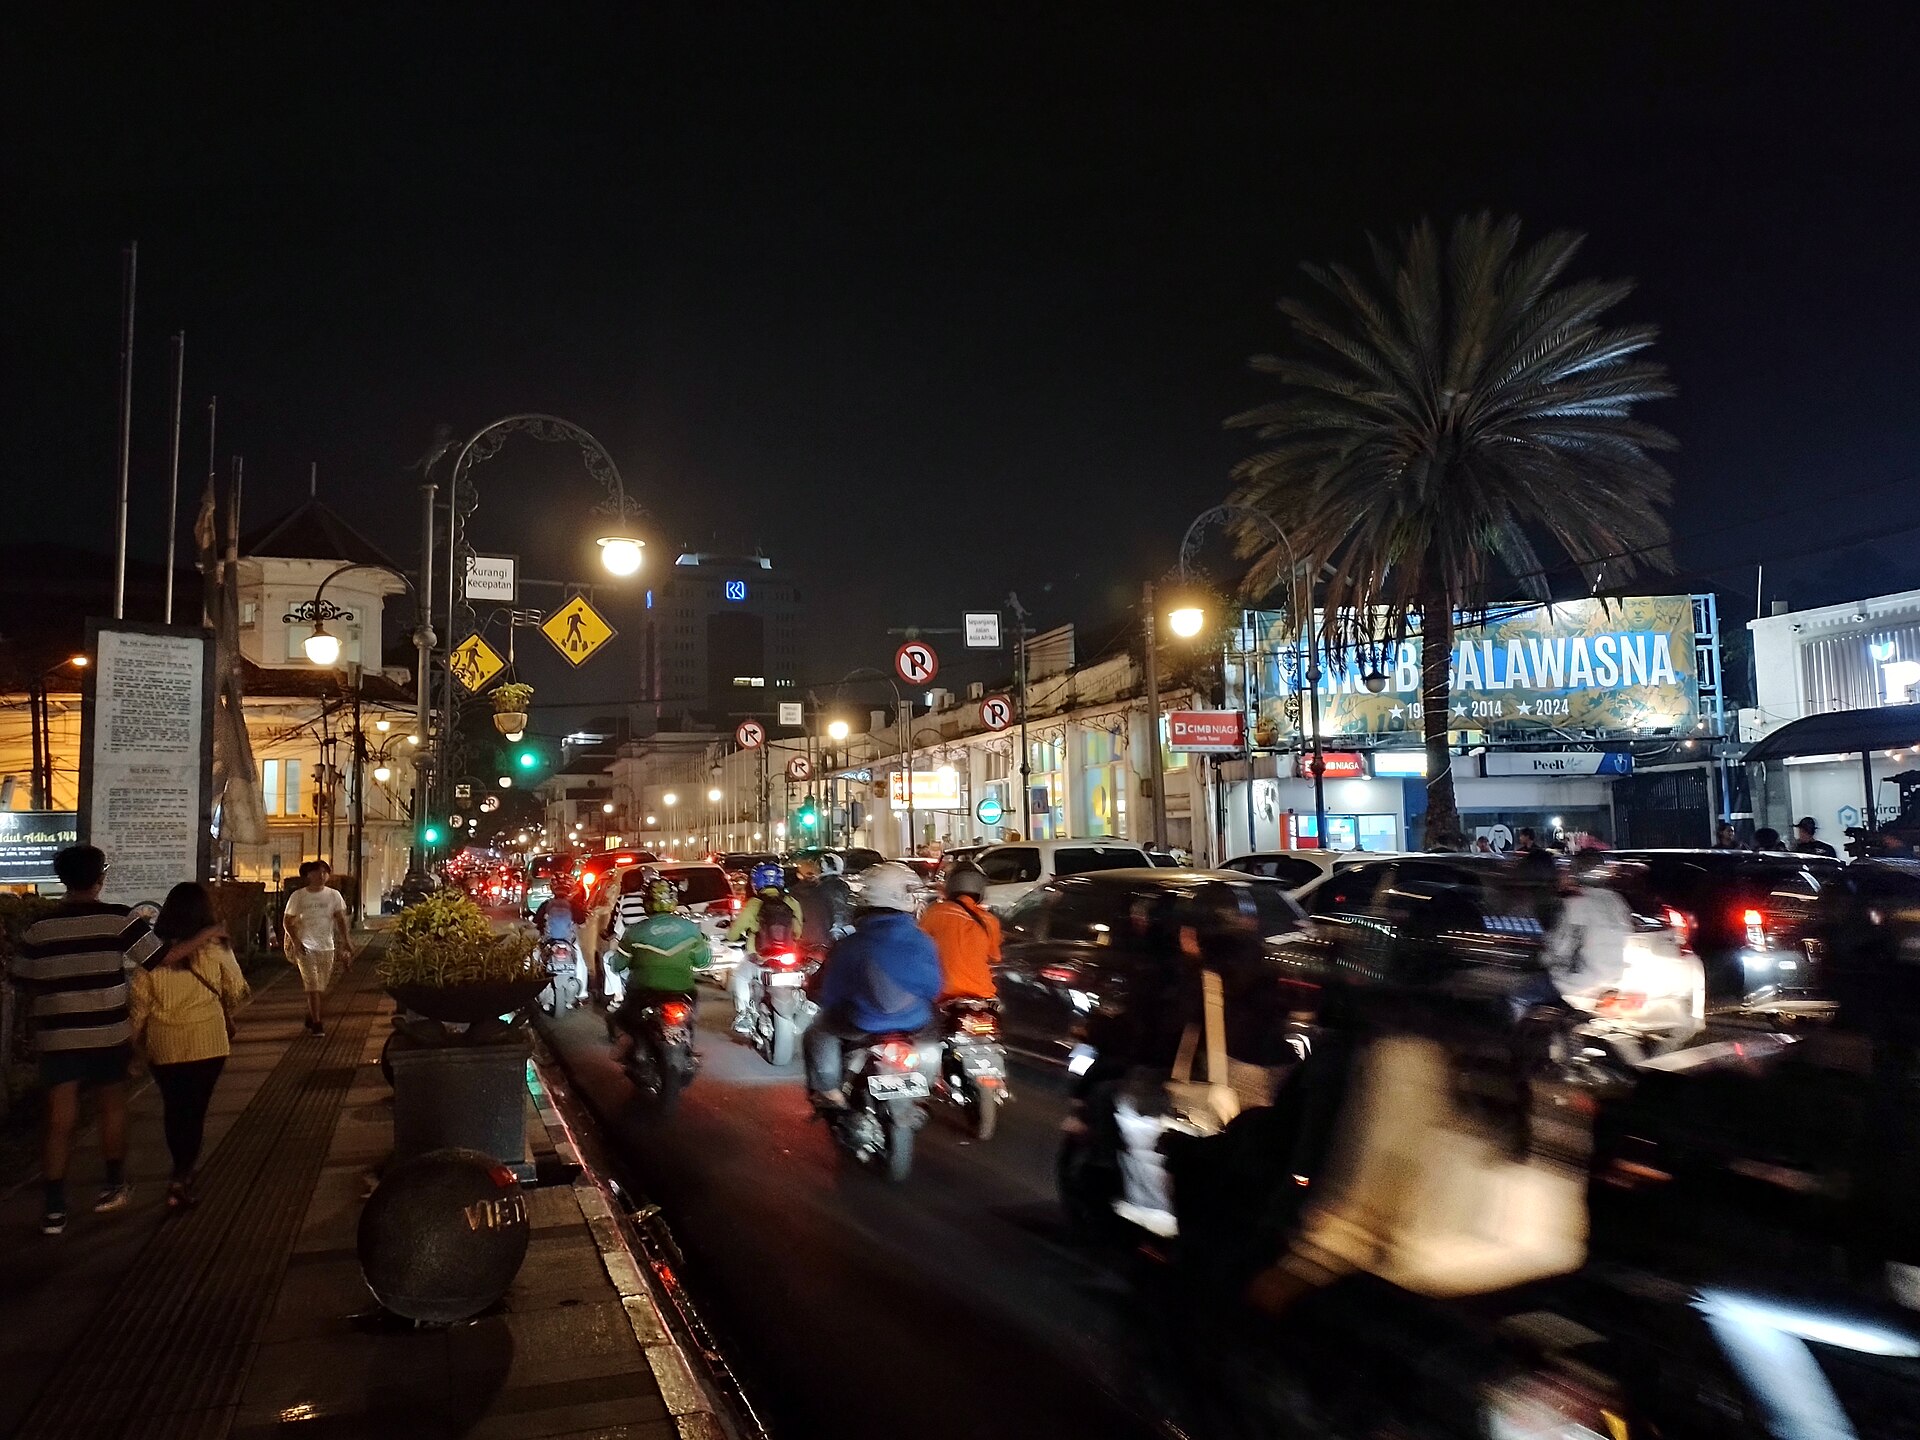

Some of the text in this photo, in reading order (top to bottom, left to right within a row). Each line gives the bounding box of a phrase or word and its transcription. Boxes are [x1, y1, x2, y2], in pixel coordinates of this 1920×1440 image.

[472, 566, 508, 580] Kurangi
[467, 578, 512, 591] Kecepatan
[1448, 634, 1677, 691] ALAWASNA
[1471, 700, 1502, 717] 2014
[1536, 698, 1569, 716] 2024
[1187, 724, 1239, 734] CIMB NIAGA
[1336, 761, 1360, 770] NIAGA
[23, 832, 56, 844] Adha
